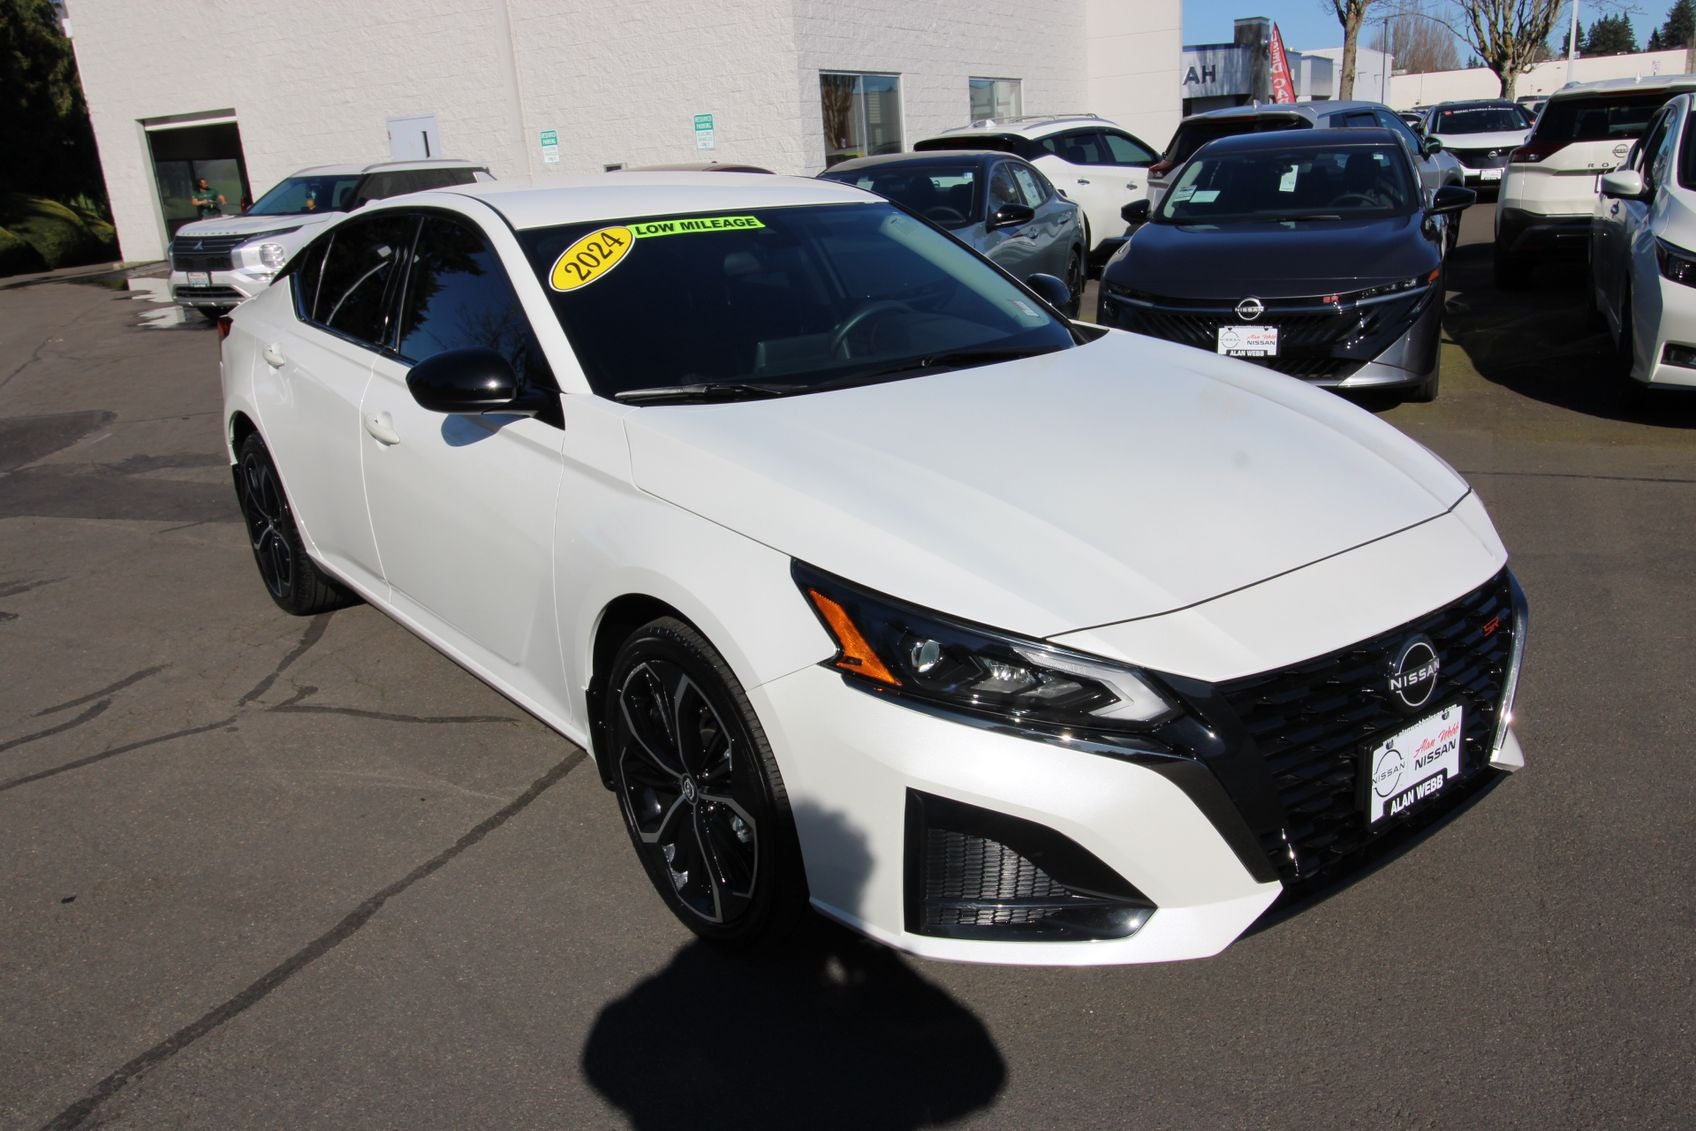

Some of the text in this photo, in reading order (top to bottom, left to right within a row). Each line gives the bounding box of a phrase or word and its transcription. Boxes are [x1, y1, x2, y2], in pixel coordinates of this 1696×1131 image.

[635, 217, 758, 236] LOW MILEAGE
[564, 231, 625, 281] 2024
[1483, 616, 1499, 637] SR
[1390, 658, 1440, 691] NISSAN
[1413, 738, 1436, 758] Alan
[1414, 739, 1457, 771] NISSAN
[1372, 761, 1406, 784] NISSAN
[1390, 774, 1444, 816] ALAN WEBB
